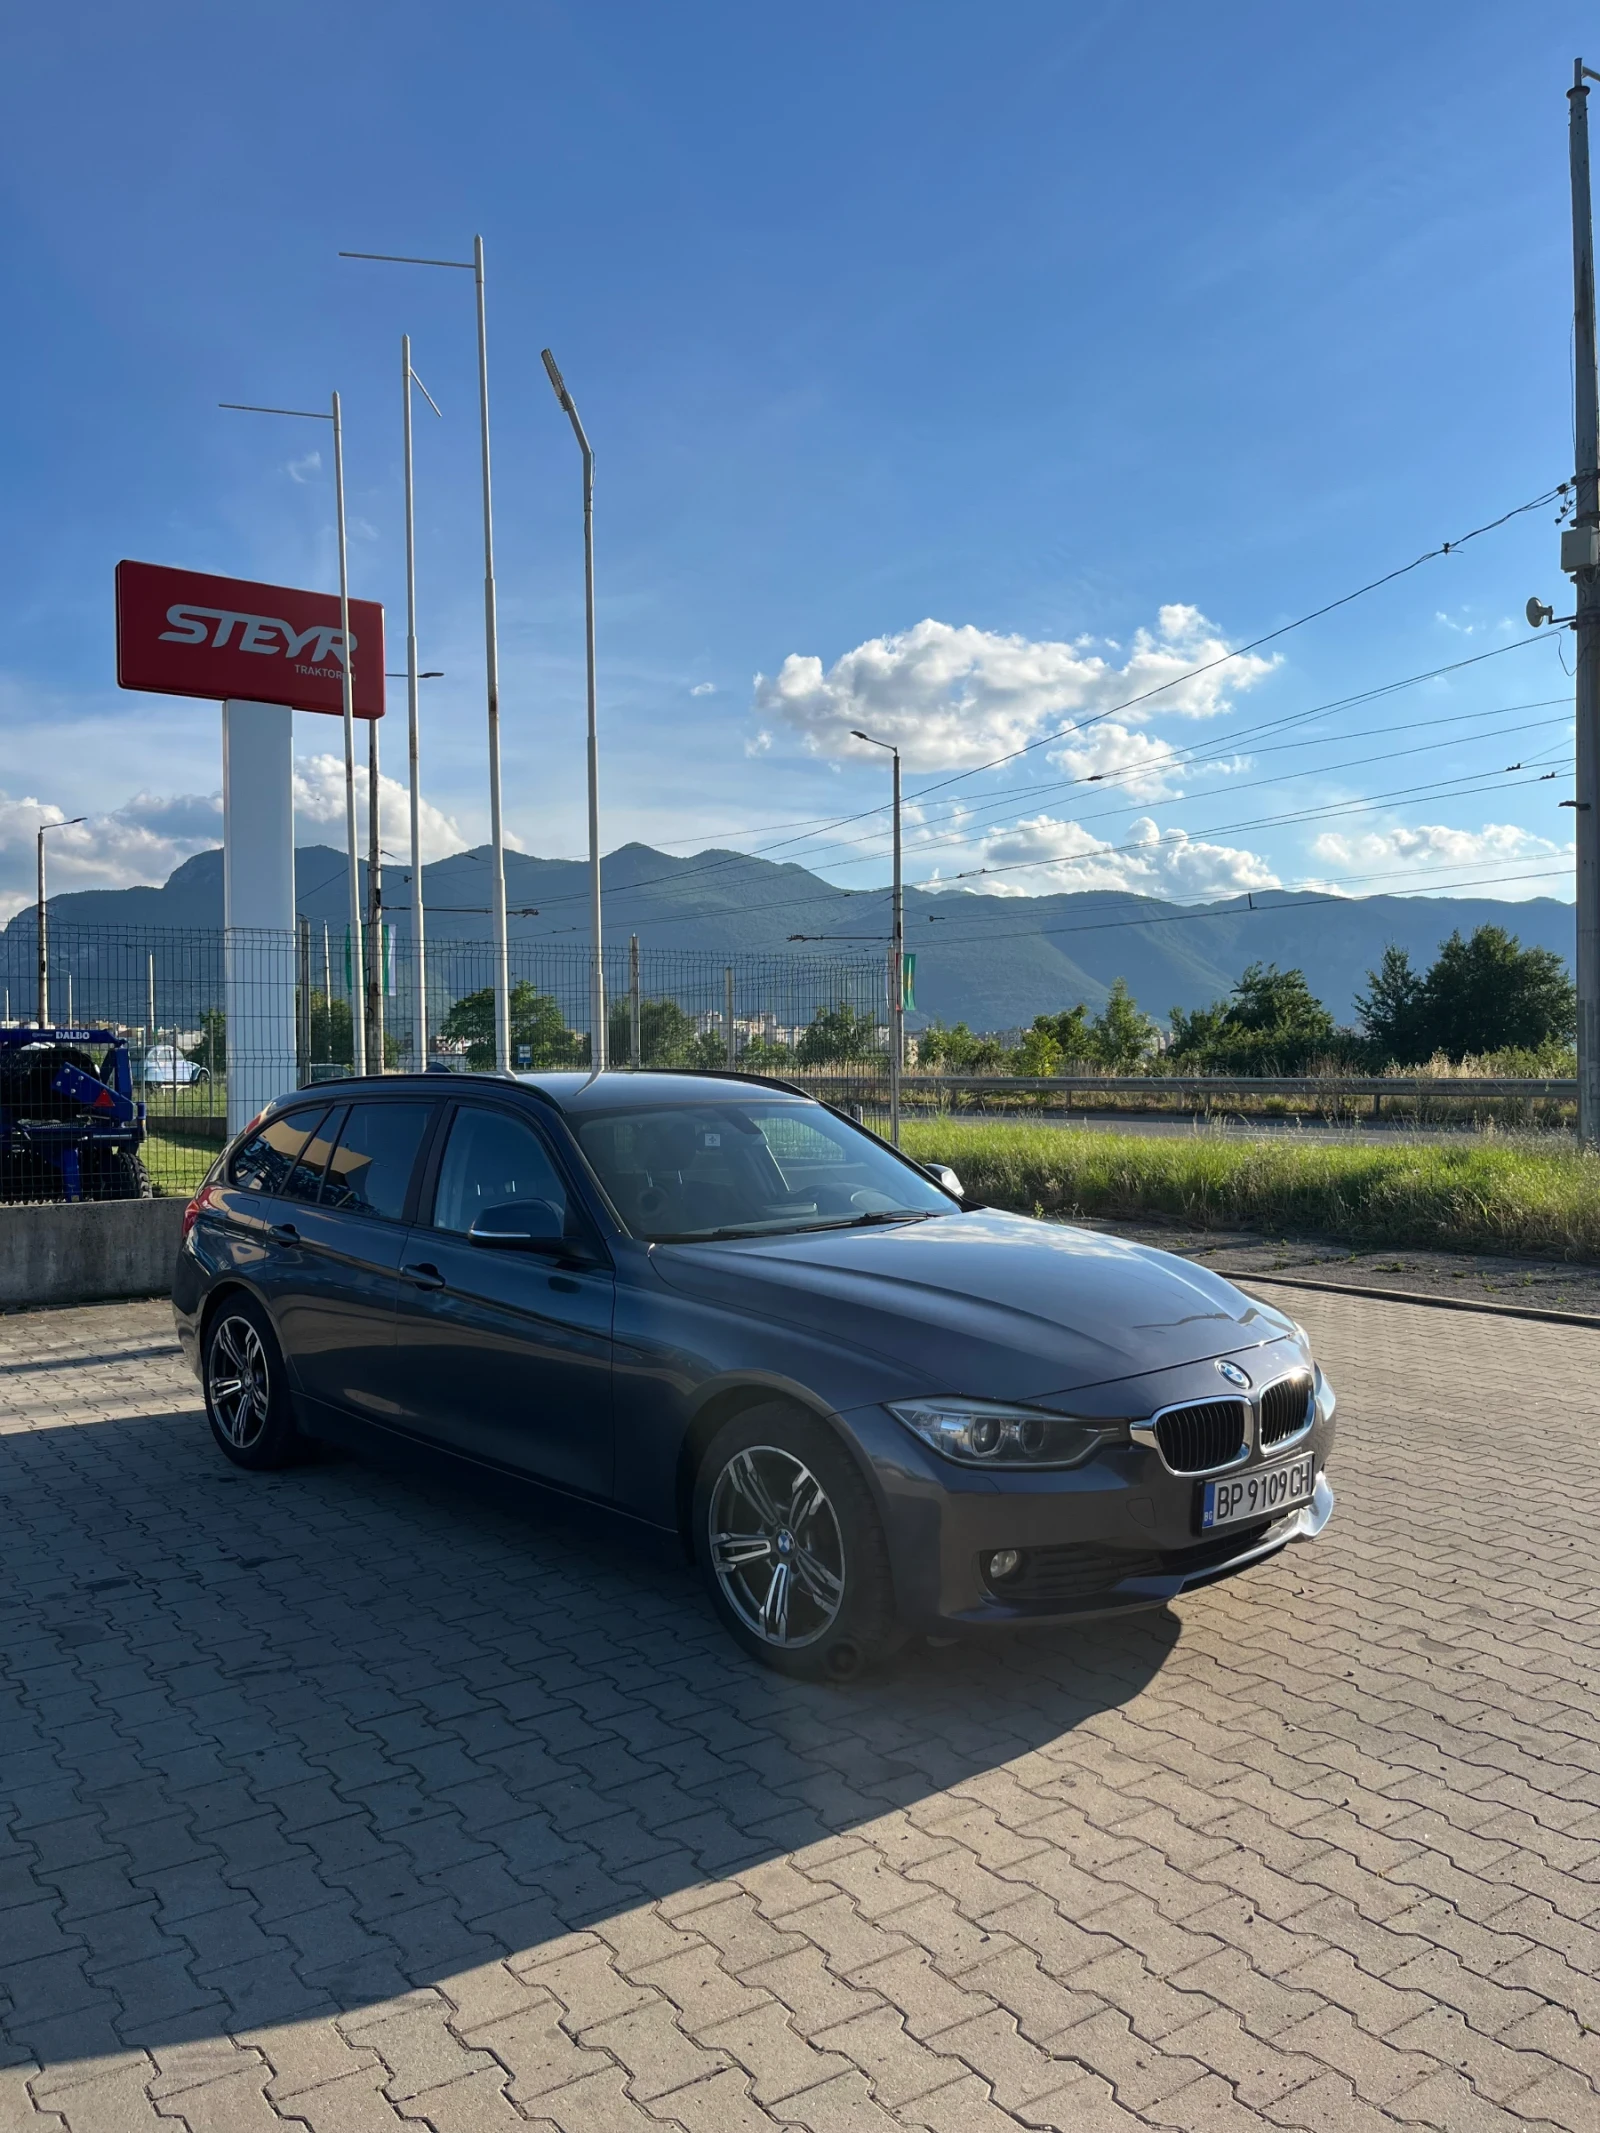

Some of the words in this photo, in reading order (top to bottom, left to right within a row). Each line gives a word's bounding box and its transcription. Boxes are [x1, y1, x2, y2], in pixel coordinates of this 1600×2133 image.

[158, 604, 358, 668] STEYR
[295, 664, 357, 682] TRAKTORN
[55, 1031, 90, 1040] DALBO
[1248, 1468, 1288, 1511] 9109
[1203, 1510, 1213, 1522] BG
